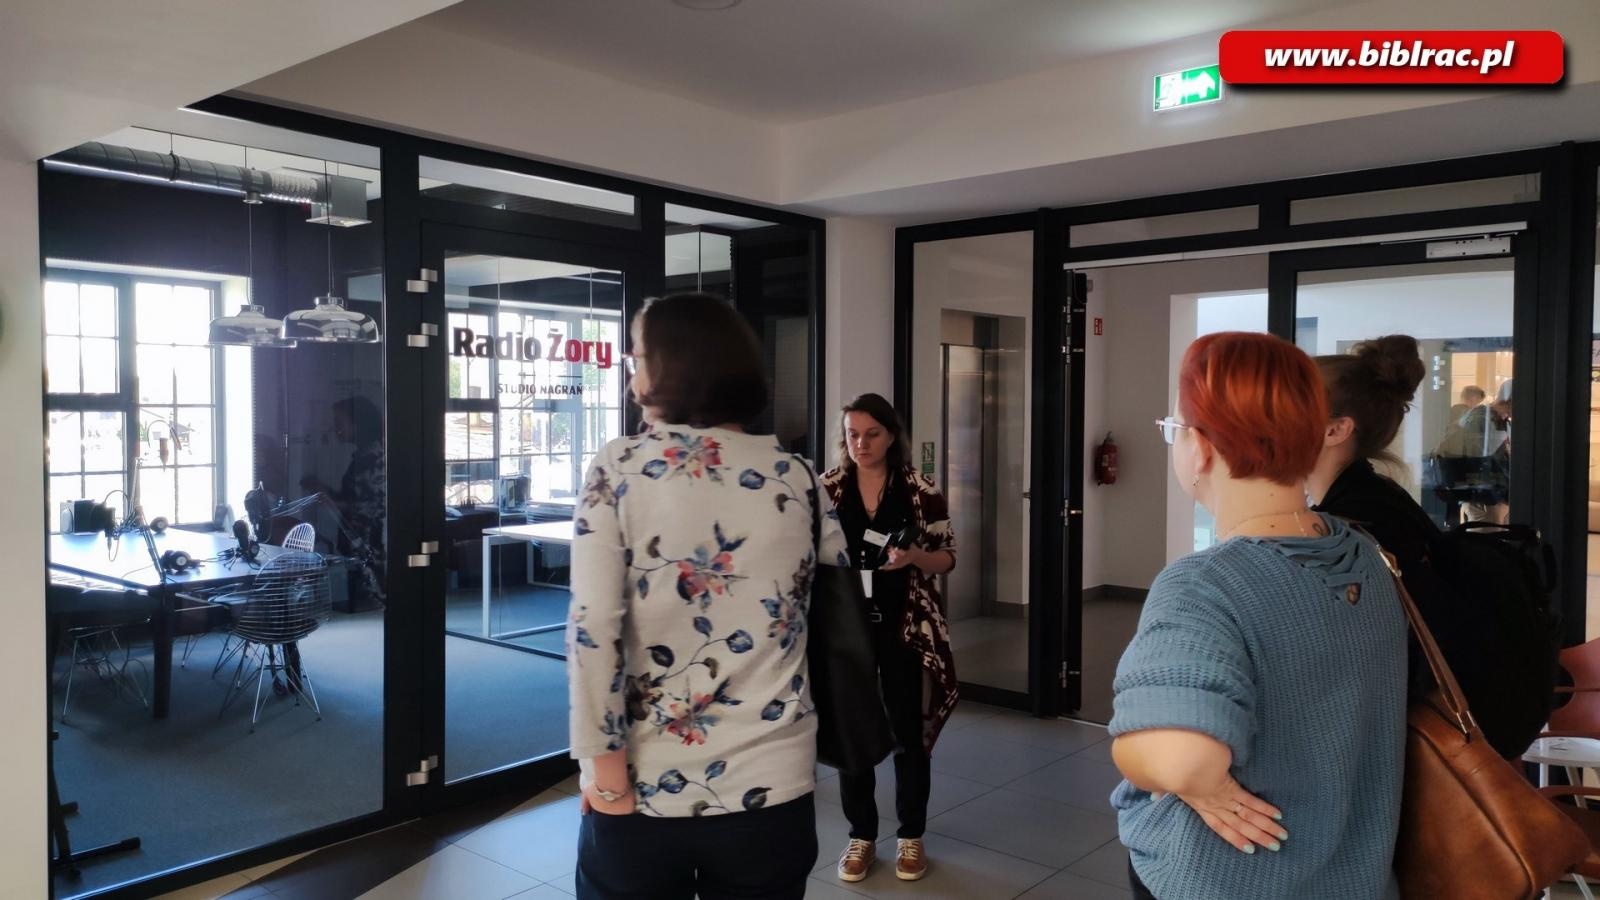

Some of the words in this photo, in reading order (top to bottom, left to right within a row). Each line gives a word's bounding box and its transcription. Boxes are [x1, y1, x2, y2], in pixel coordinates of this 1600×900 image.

[453, 326, 541, 361] Radio
[547, 328, 612, 369] Żory
[498, 383, 536, 395] STUDIO
[539, 382, 583, 396] NAGRAŃ
